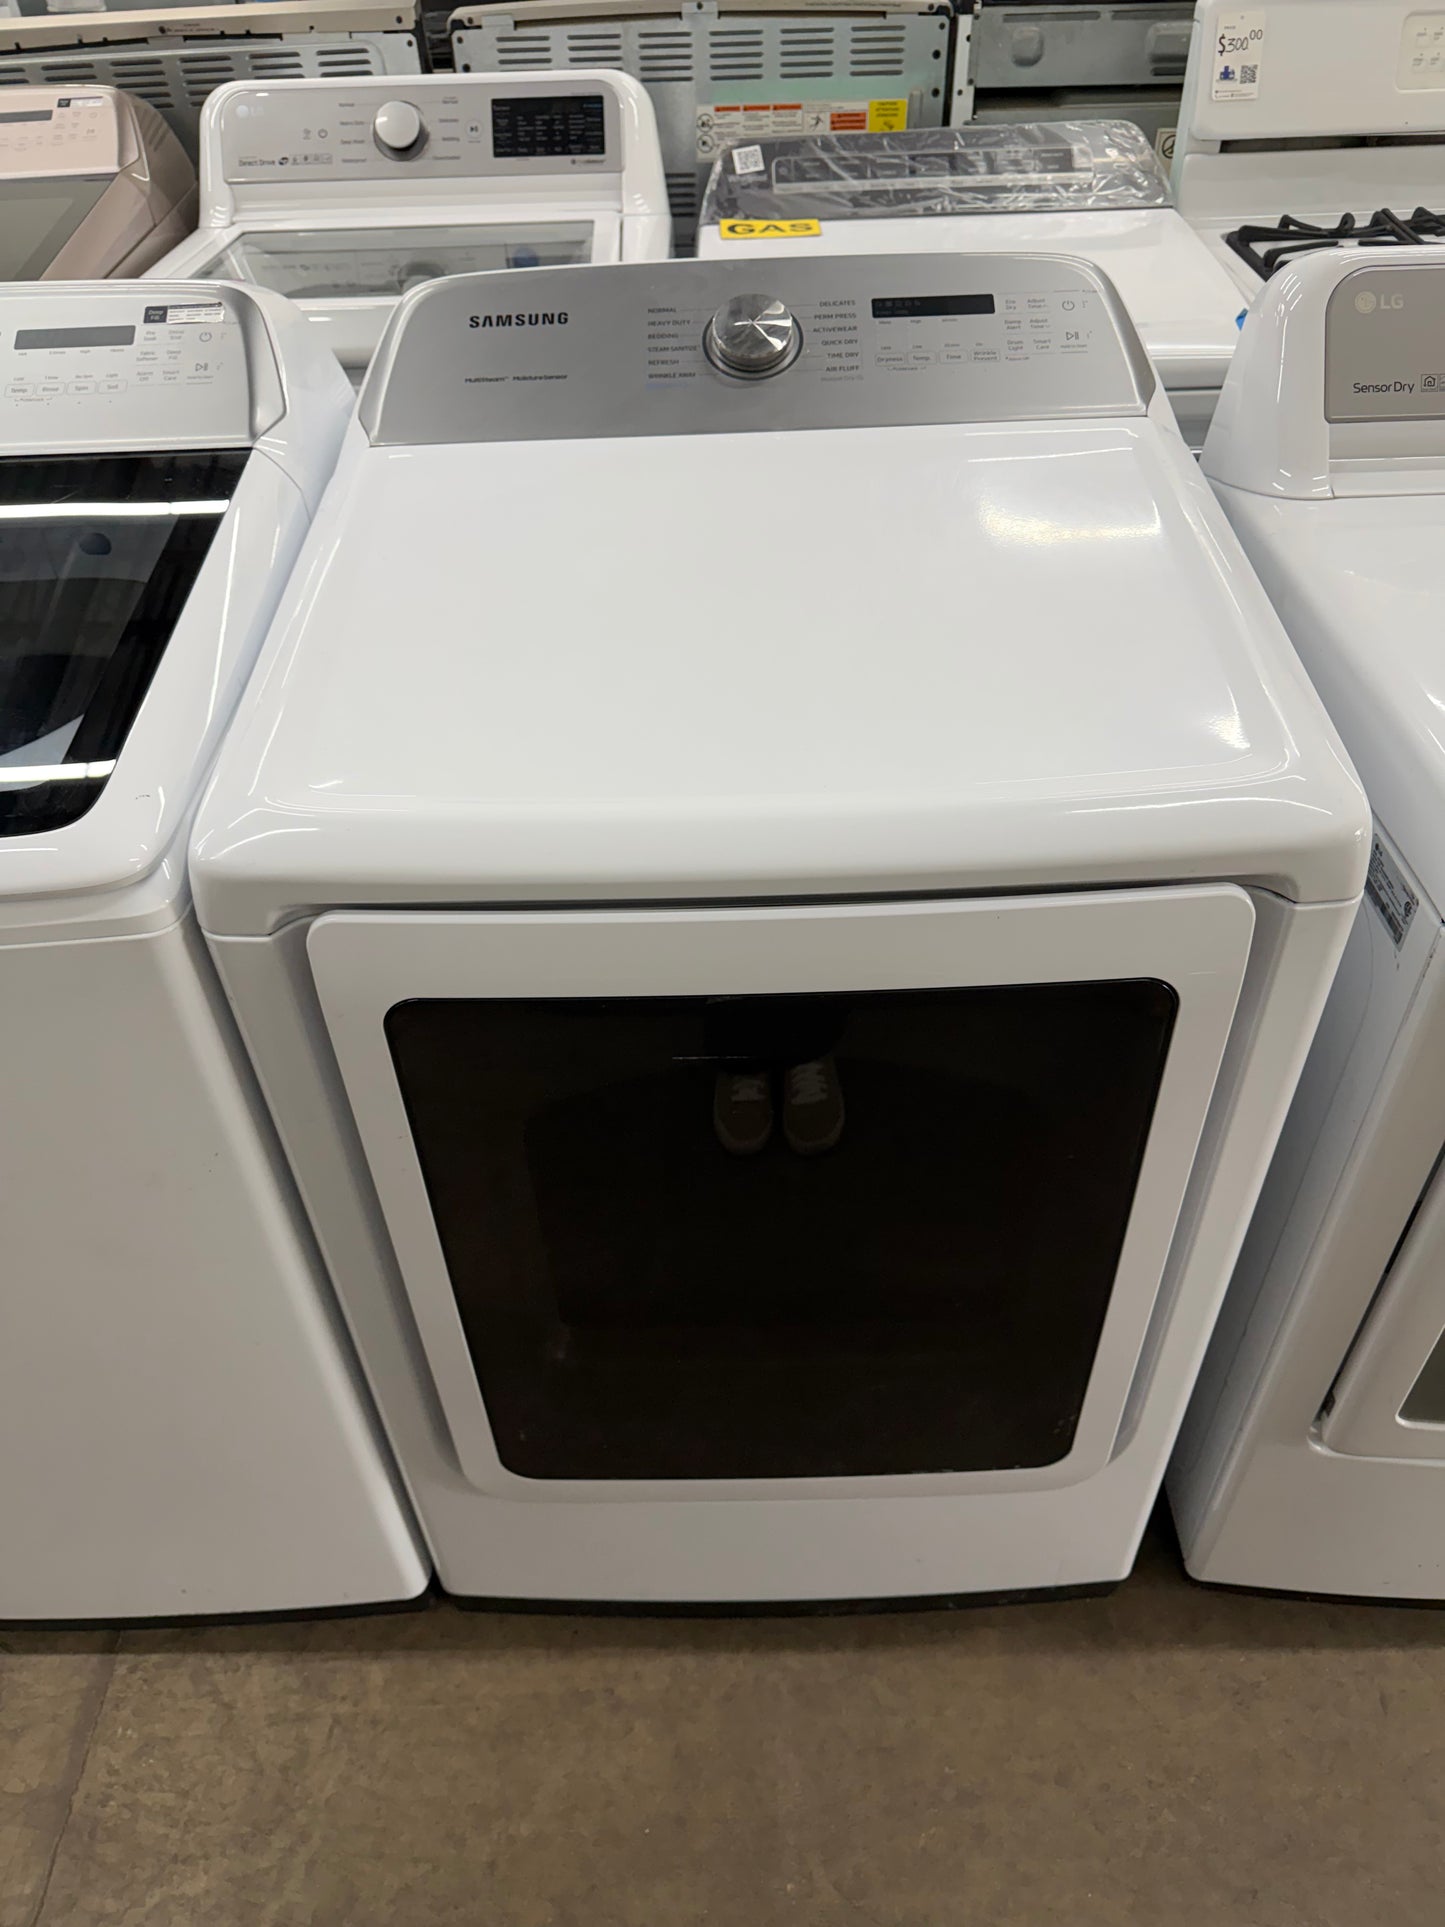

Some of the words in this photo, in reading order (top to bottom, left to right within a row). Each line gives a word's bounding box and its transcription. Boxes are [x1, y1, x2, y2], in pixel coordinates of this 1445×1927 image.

[727, 222, 813, 235] GAS
[819, 300, 856, 308] DELICATES
[1380, 294, 1404, 309] LG
[469, 312, 569, 329] SAMSUNG
